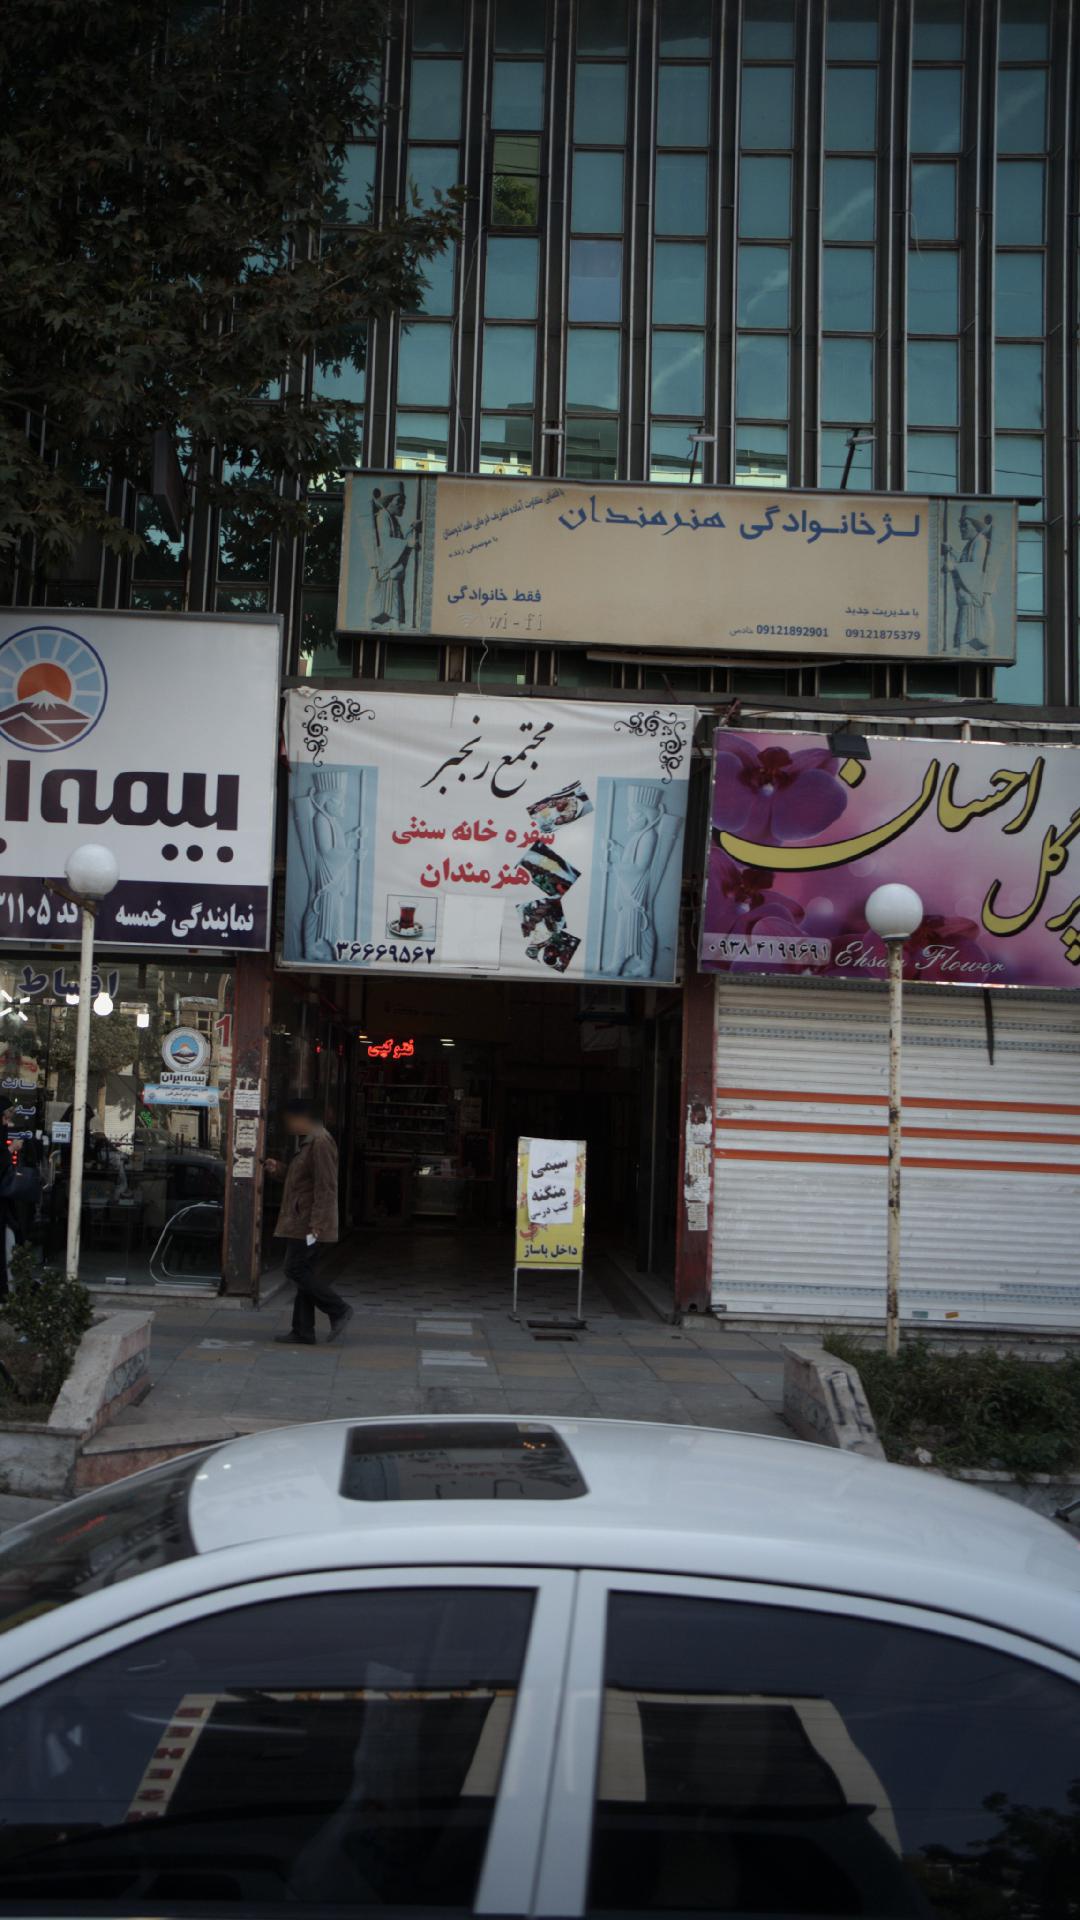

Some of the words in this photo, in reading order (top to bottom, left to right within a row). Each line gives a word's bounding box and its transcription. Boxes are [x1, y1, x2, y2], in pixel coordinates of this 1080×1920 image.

[558, 495, 726, 536] هنرمندان
[447, 584, 508, 606] خانوادگی
[513, 588, 542, 602] فقط
[845, 606, 869, 616] جدید
[872, 606, 910, 617] مدیریت
[756, 624, 829, 638] 09121892901
[845, 628, 921, 641] 09121875379
[421, 714, 490, 795] رنجبر
[490, 721, 555, 798] مجتمع
[41, 768, 240, 863] بیمه
[716, 756, 1046, 873] احسان
[391, 816, 446, 845] سنتی
[451, 818, 498, 842] خانه
[505, 820, 555, 848] سفره
[420, 857, 531, 889] هنرمندان
[115, 899, 166, 928] خمسه
[171, 902, 254, 938] نمایندگی
[336, 941, 436, 964] ۳۶۶۶۹۵۶۲
[834, 941, 906, 968] Ehsa
[915, 944, 1005, 973] Flower
[161, 1073, 183, 1085] ایران
[184, 1075, 206, 1086] بیمه
[531, 1160, 568, 1178] سیمی
[532, 1184, 566, 1201] منگنه
[551, 1245, 578, 1258] داخل
